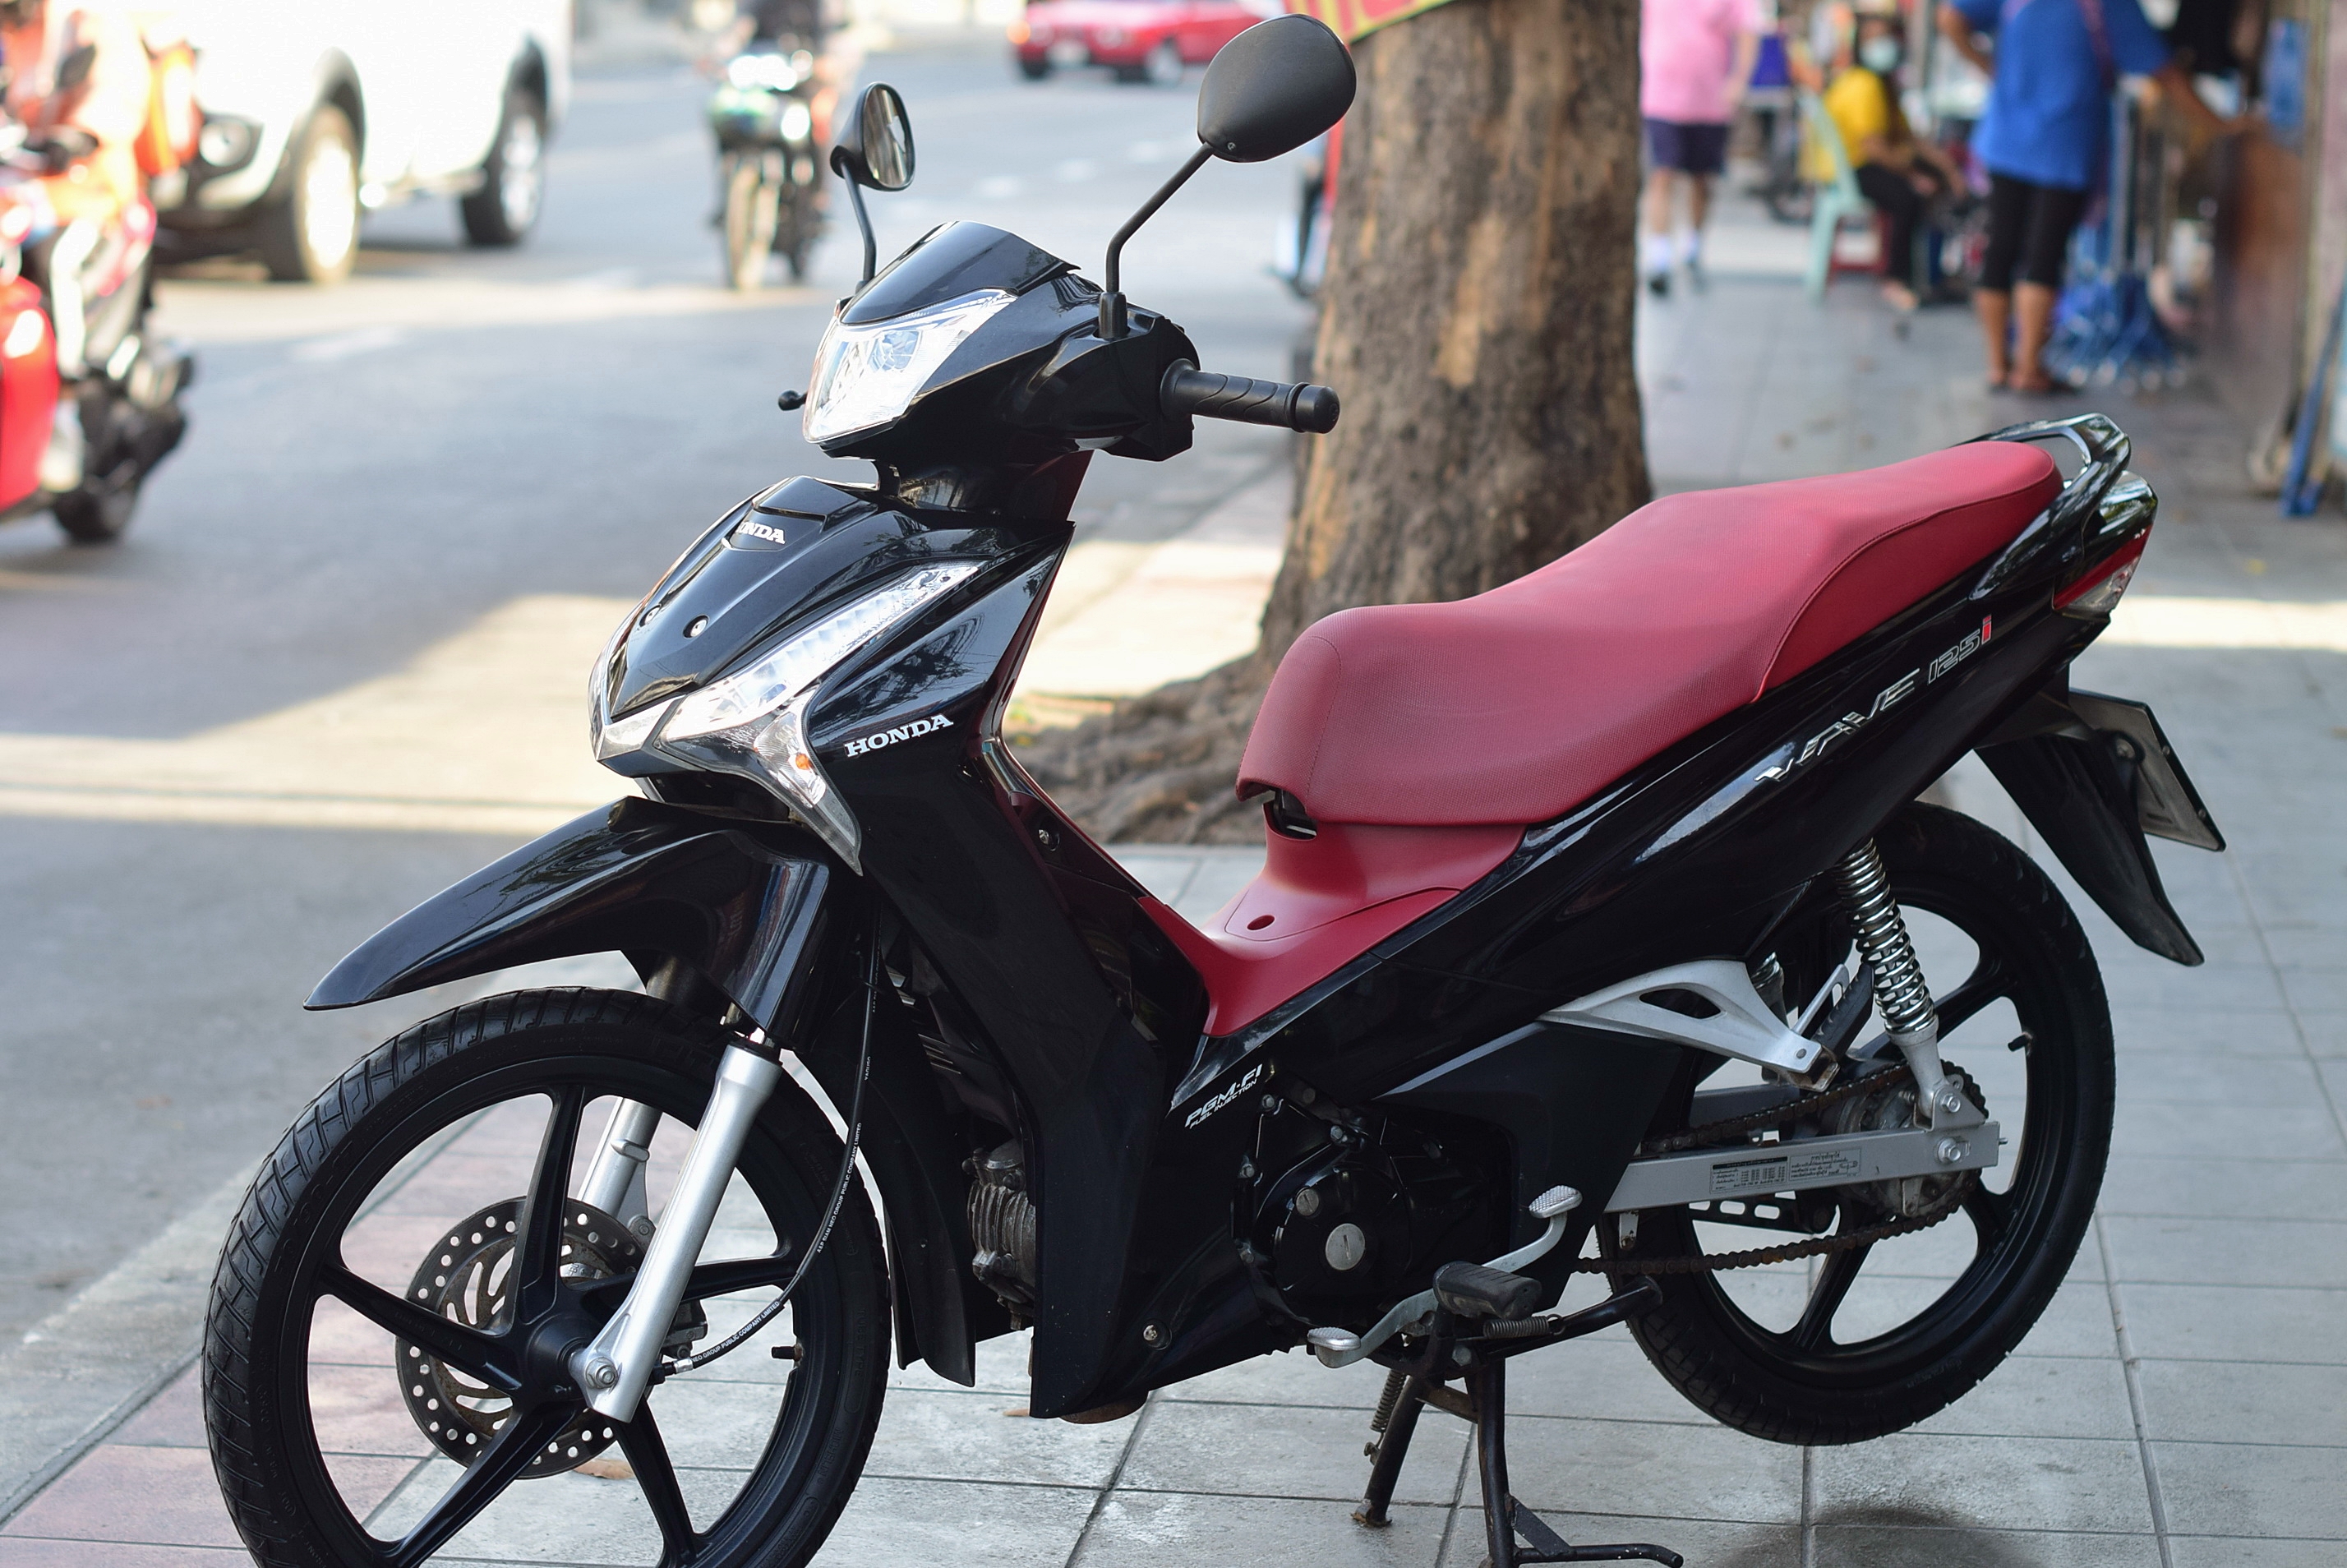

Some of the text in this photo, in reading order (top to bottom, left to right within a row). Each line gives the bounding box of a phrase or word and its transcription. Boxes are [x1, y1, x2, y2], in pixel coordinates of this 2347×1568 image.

[735, 521, 786, 545] ONDA
[1754, 614, 1992, 782] WAVE 125i
[844, 713, 954, 758] HONDA
[1184, 1063, 1263, 1128] PGM-FI
[1189, 1078, 1257, 1129] FUEL INJECTION
[828, 1215, 837, 1228] NEO
[833, 1195, 843, 1215] GROUP
[841, 1174, 851, 1195] PUBLIC
[854, 1123, 862, 1146] LIMITED
[703, 1345, 722, 1358] GROUP
[721, 1334, 740, 1349] PUBLIC
[739, 1316, 763, 1336] COMPANY
[761, 1301, 781, 1319] LIMITED
